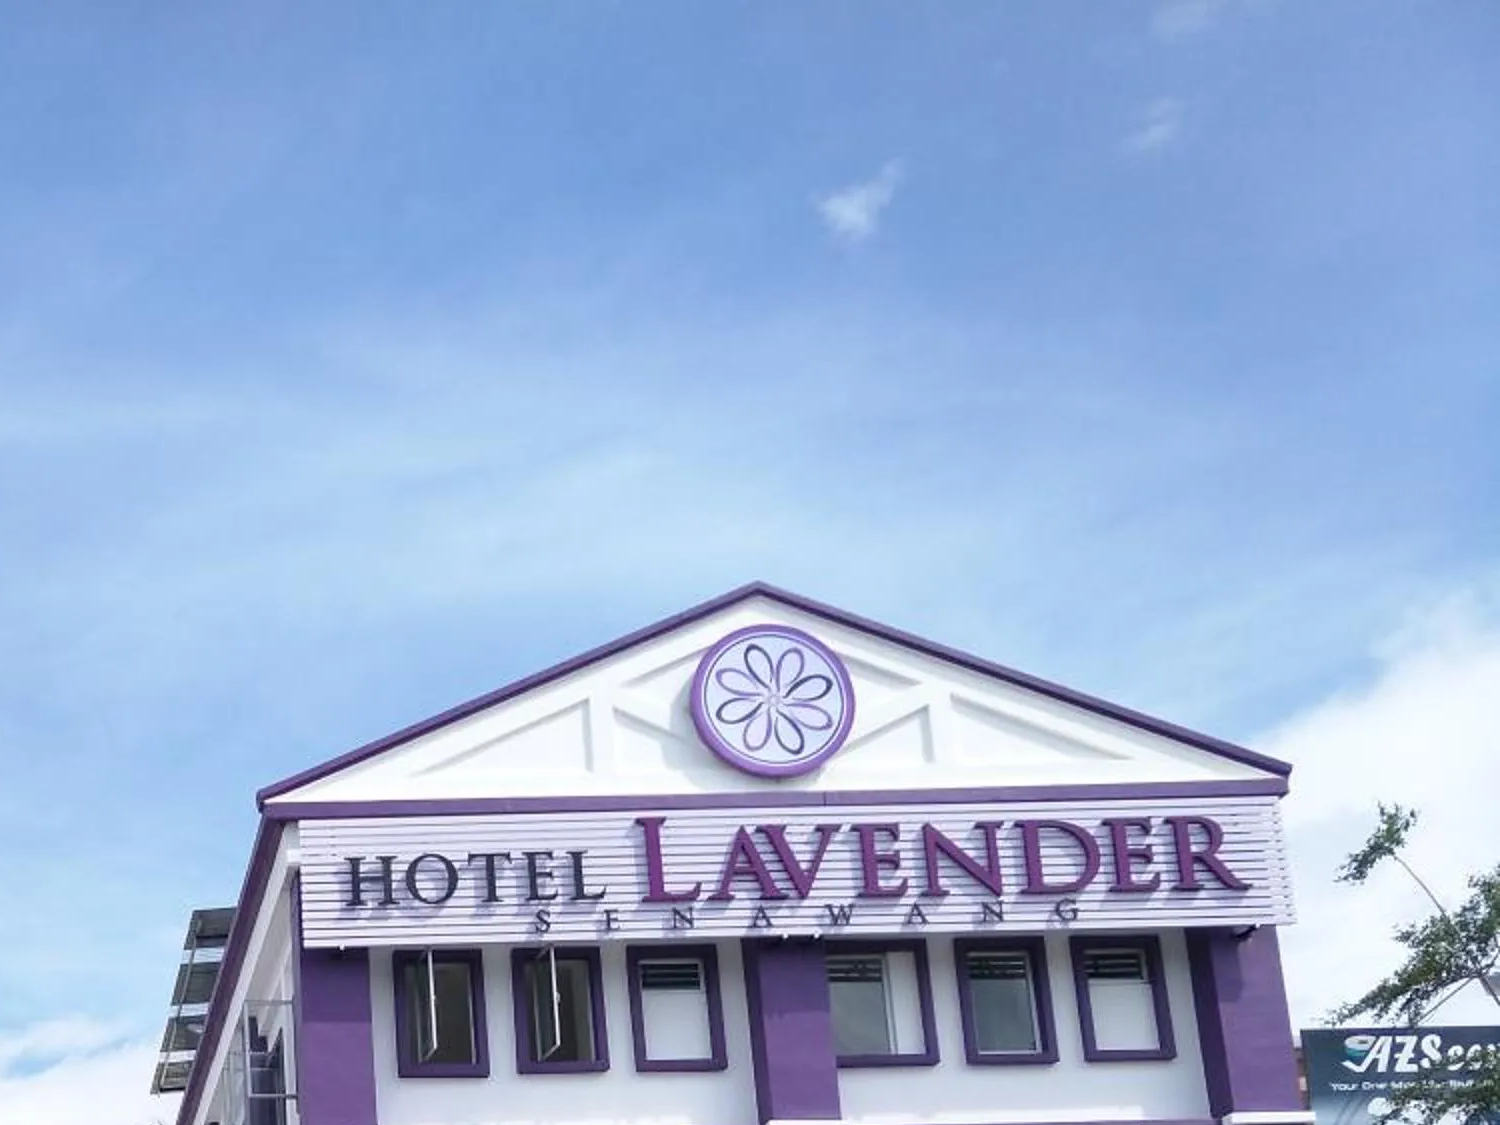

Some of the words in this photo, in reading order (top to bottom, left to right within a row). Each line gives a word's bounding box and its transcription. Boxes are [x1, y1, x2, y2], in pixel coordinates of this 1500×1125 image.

[343, 850, 607, 906] HOTEL
[634, 815, 1254, 903] LAVENDER
[534, 898, 1079, 934] SENAWANG
